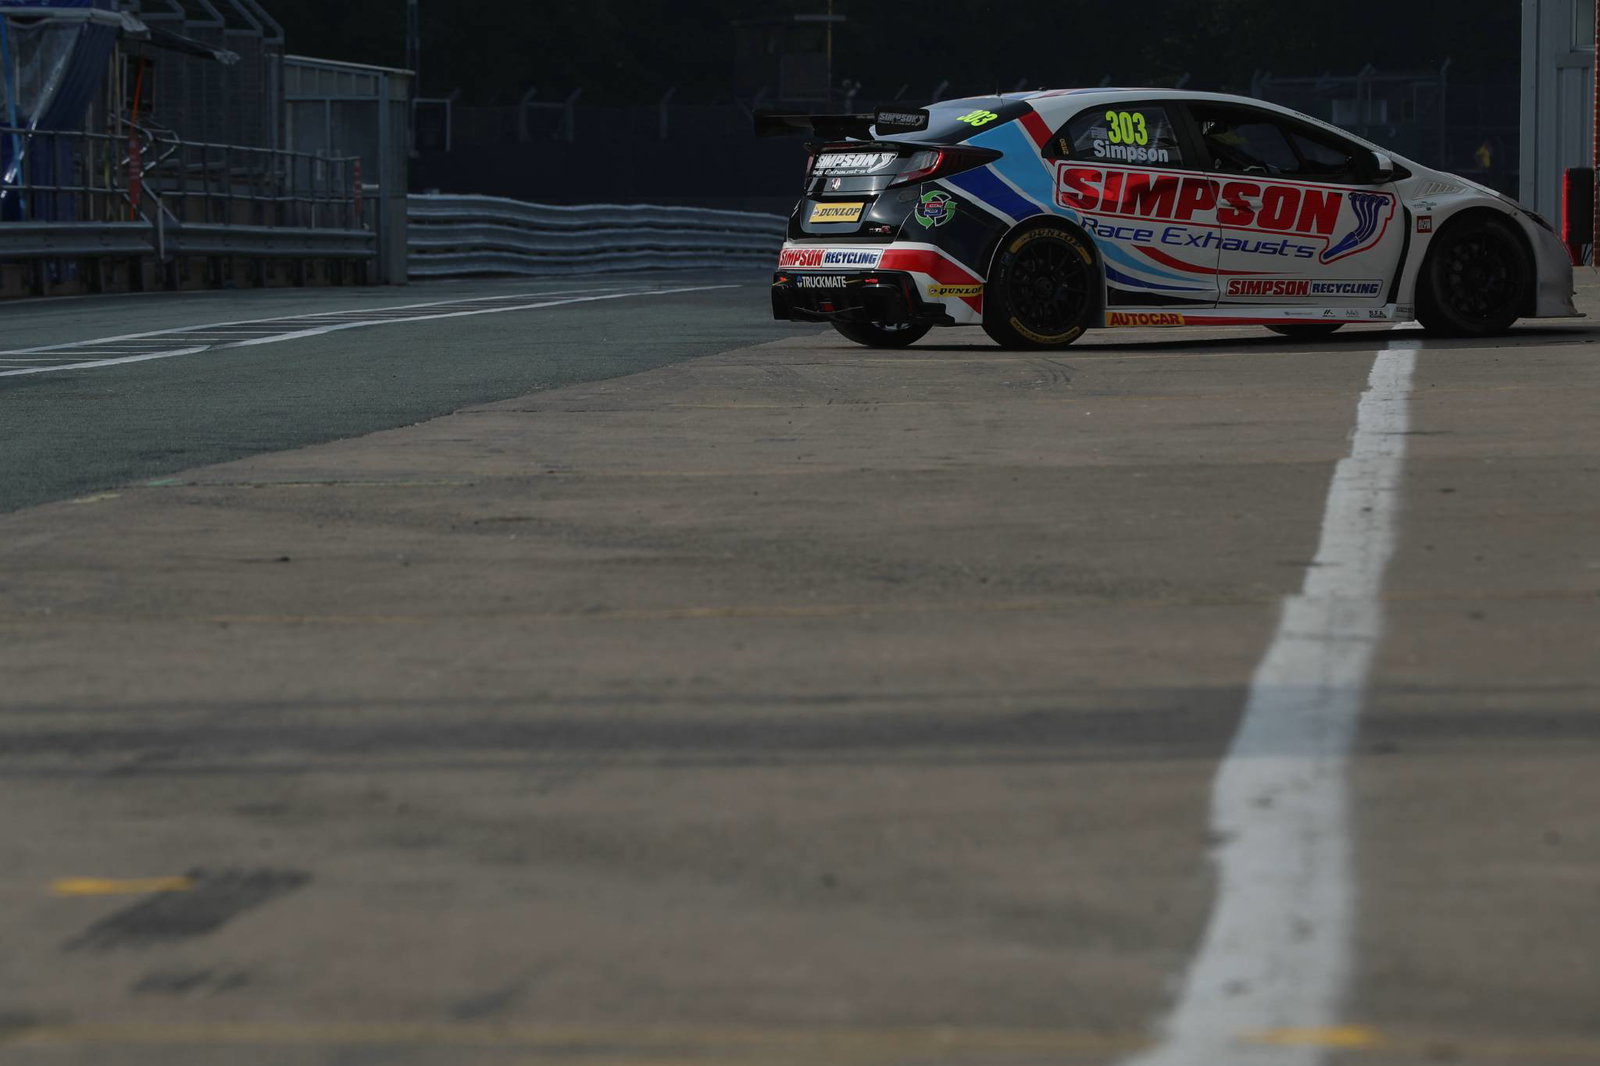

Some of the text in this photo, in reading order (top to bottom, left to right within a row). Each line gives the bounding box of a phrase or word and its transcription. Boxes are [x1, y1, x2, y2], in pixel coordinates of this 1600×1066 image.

[1104, 110, 1149, 146] 303
[1093, 139, 1169, 164] Simpson
[815, 153, 880, 168] SIMPSON
[1061, 168, 1343, 235] SIMPSON
[819, 207, 862, 217] DUNLOP
[1080, 216, 1316, 259] Race Exhausts
[779, 249, 878, 267] SIMPSON RECYCLING
[801, 275, 847, 288] TRUCKMATE
[1228, 280, 1380, 296] SIMPSON RECYCLING
[1110, 312, 1180, 326] AUTOCAR
